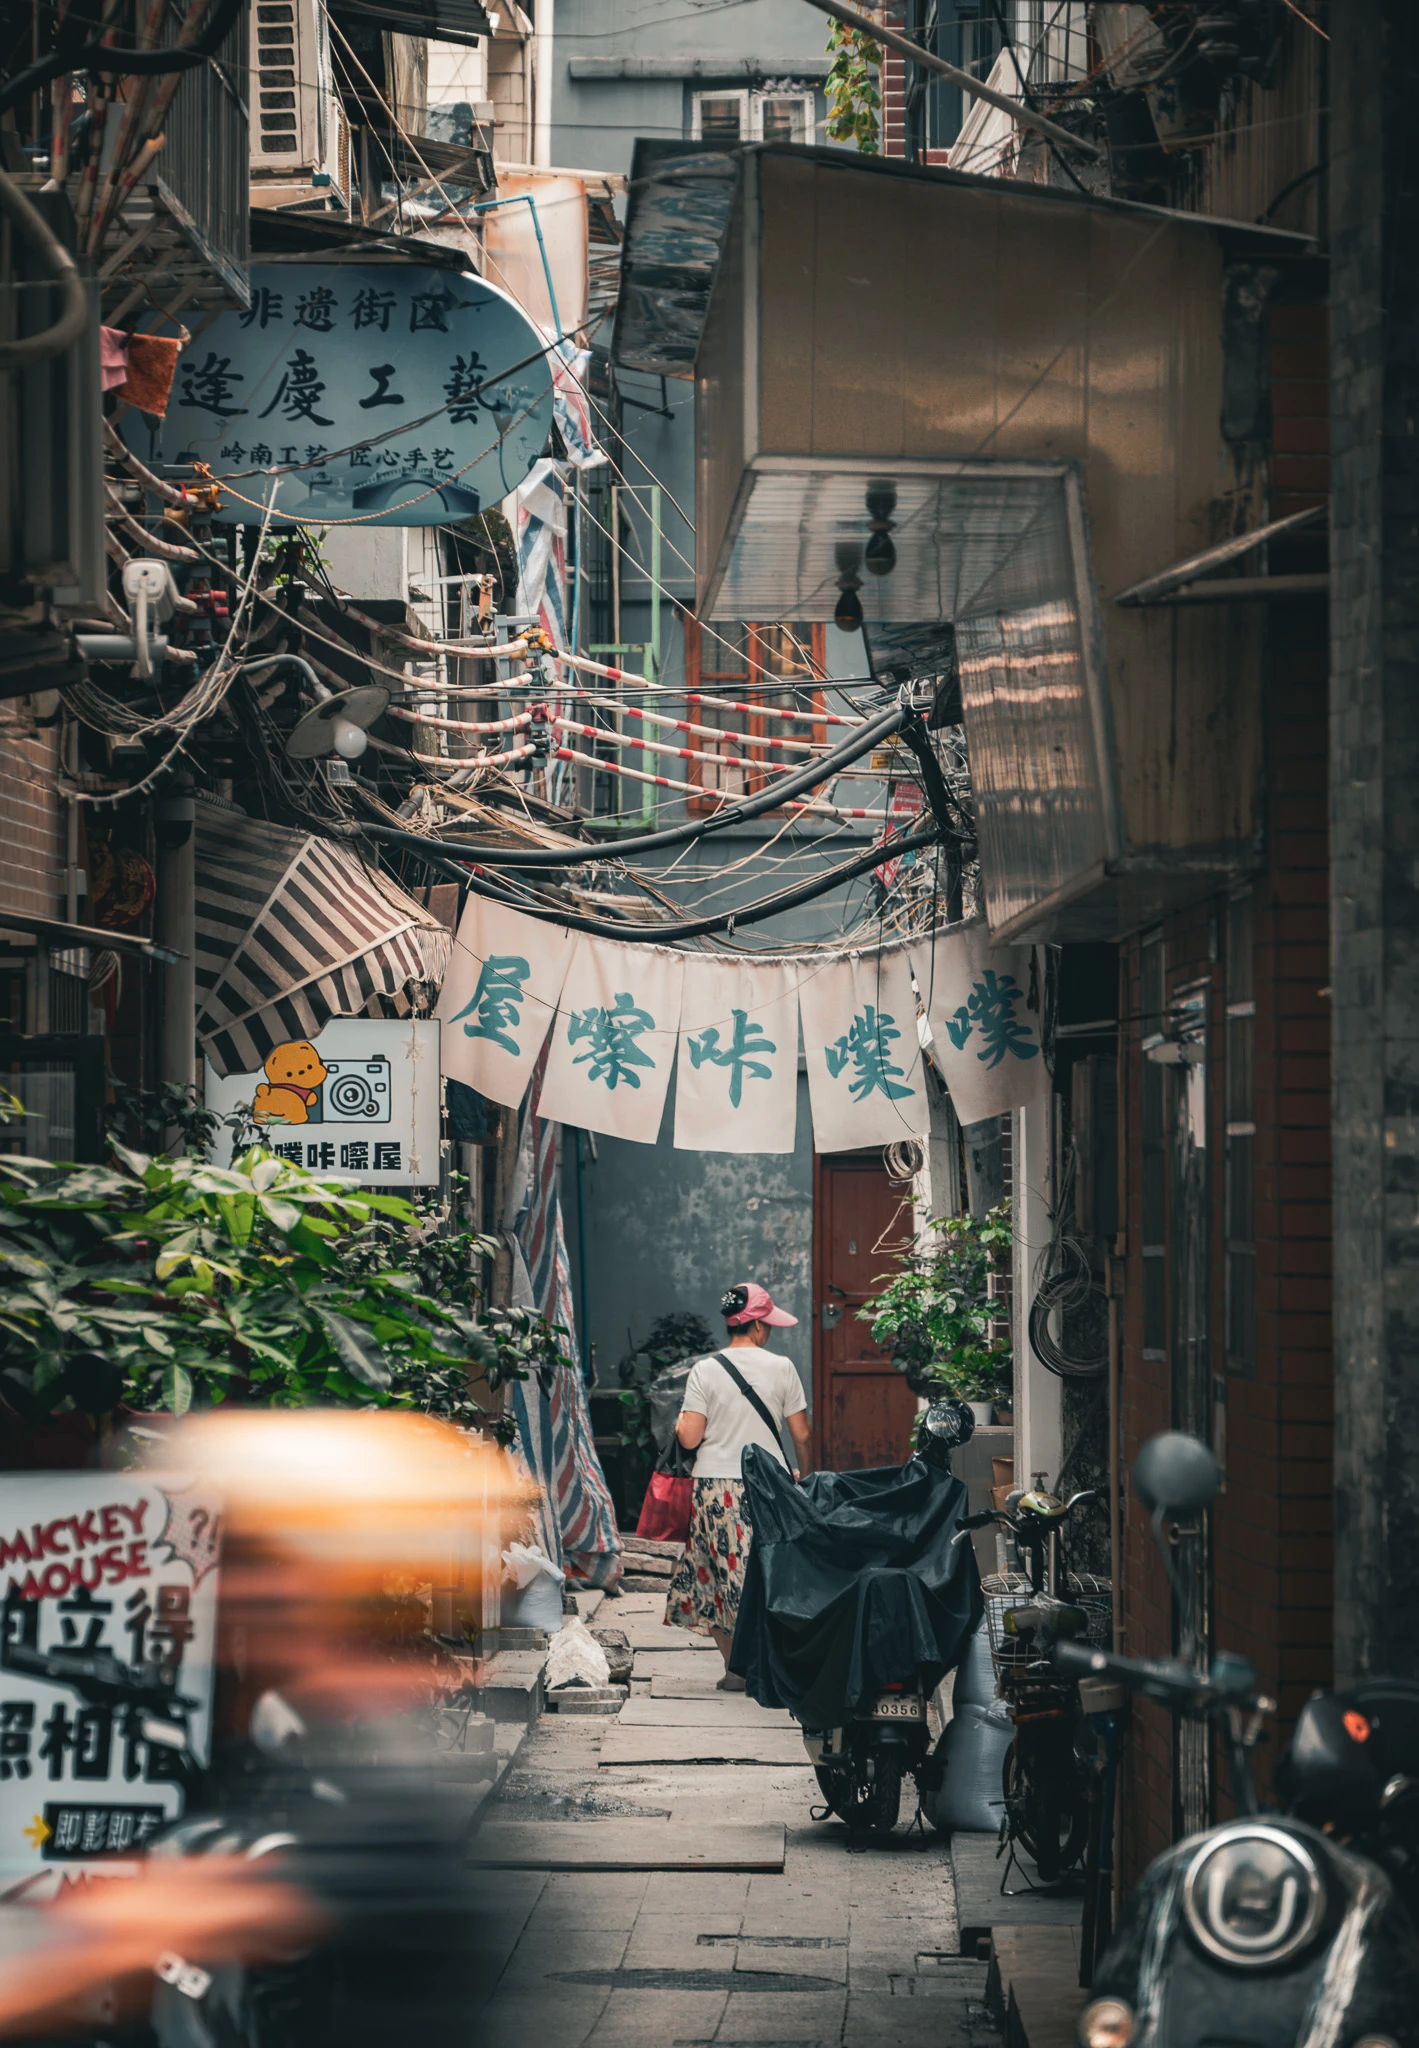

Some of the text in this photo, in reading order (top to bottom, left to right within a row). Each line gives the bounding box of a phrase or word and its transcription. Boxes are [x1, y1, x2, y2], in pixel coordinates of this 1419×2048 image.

[238, 286, 451, 333] 非遗街区
[178, 349, 501, 427] 逢慶工藝
[220, 440, 455, 470] 岭南工艺 匠心手艺
[242, 1141, 402, 1171] 噗咔嚓屋
[0, 1498, 149, 1571] MICKEY
[8, 1540, 151, 1601] MOUSE
